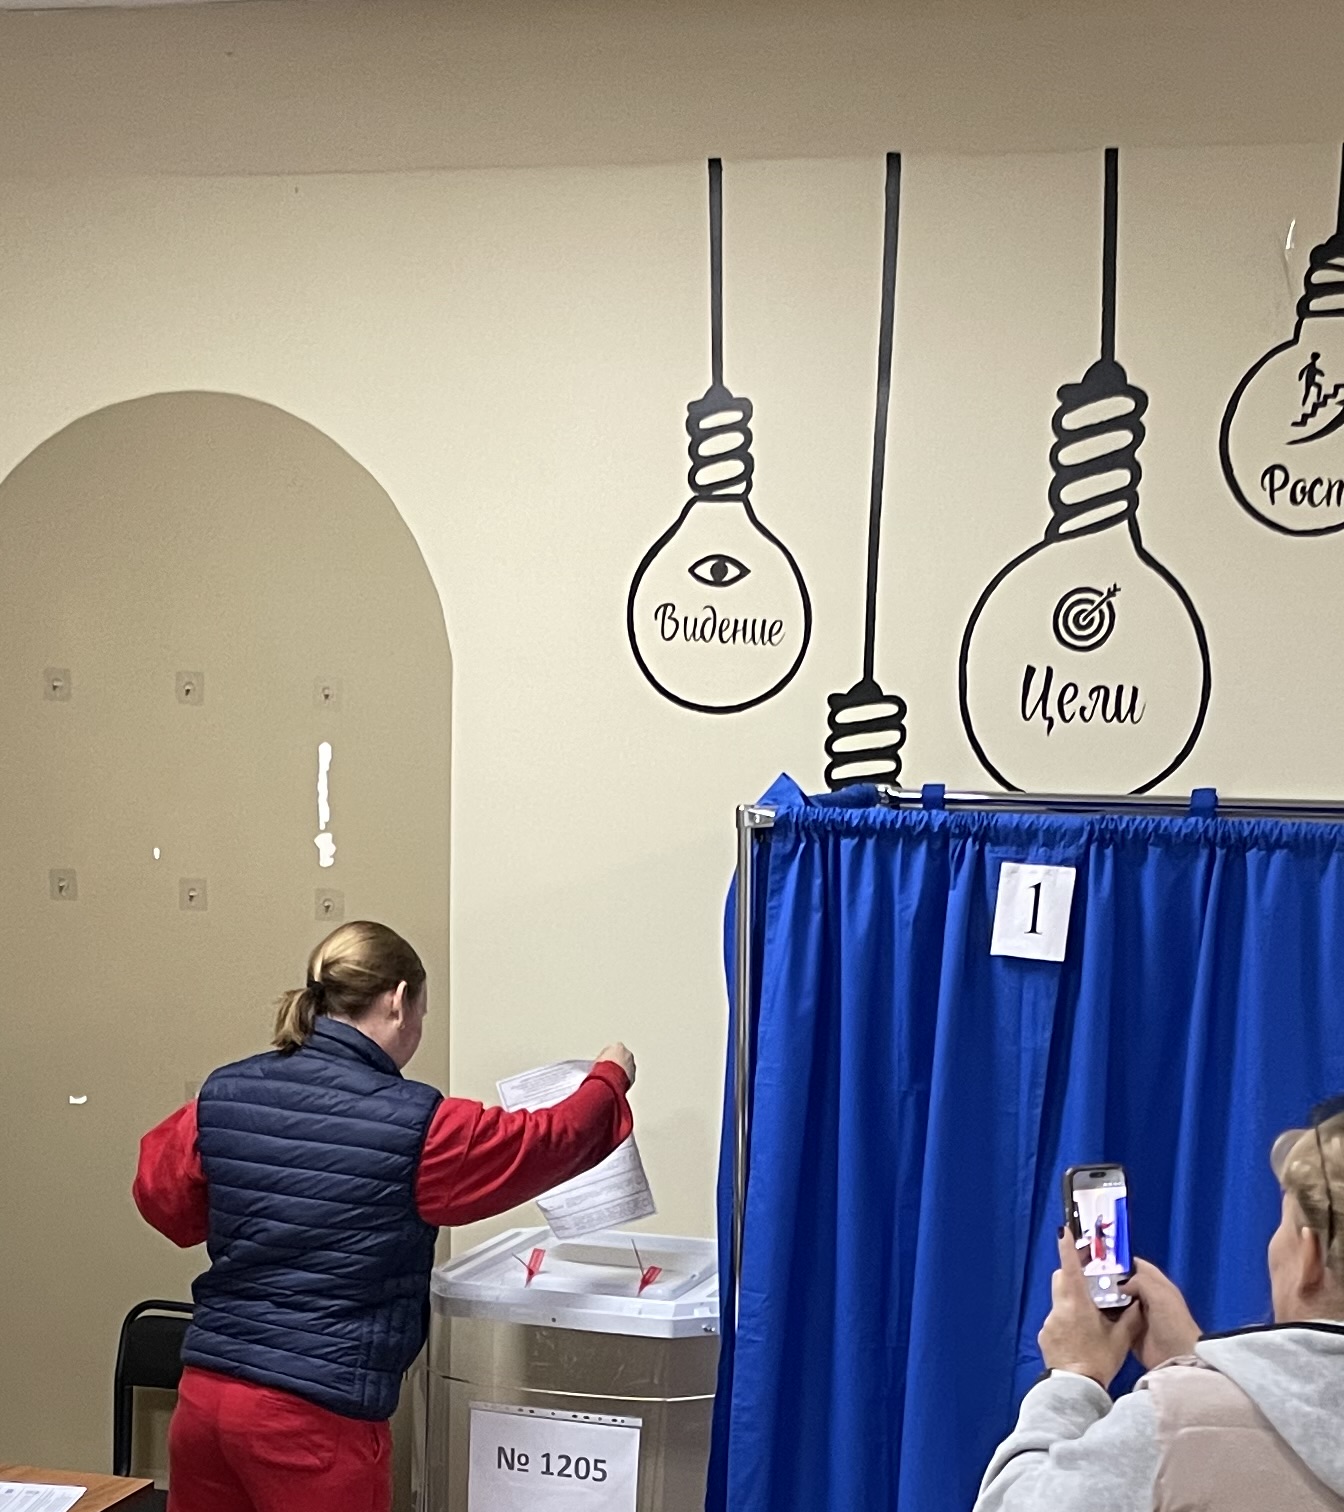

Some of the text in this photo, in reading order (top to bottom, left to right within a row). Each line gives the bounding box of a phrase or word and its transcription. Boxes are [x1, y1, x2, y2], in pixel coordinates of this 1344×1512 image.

[654, 602, 786, 648] Видение
[1020, 664, 1147, 737] Цели
[1024, 881, 1043, 936] 1
[497, 1445, 609, 1483] № 1205
